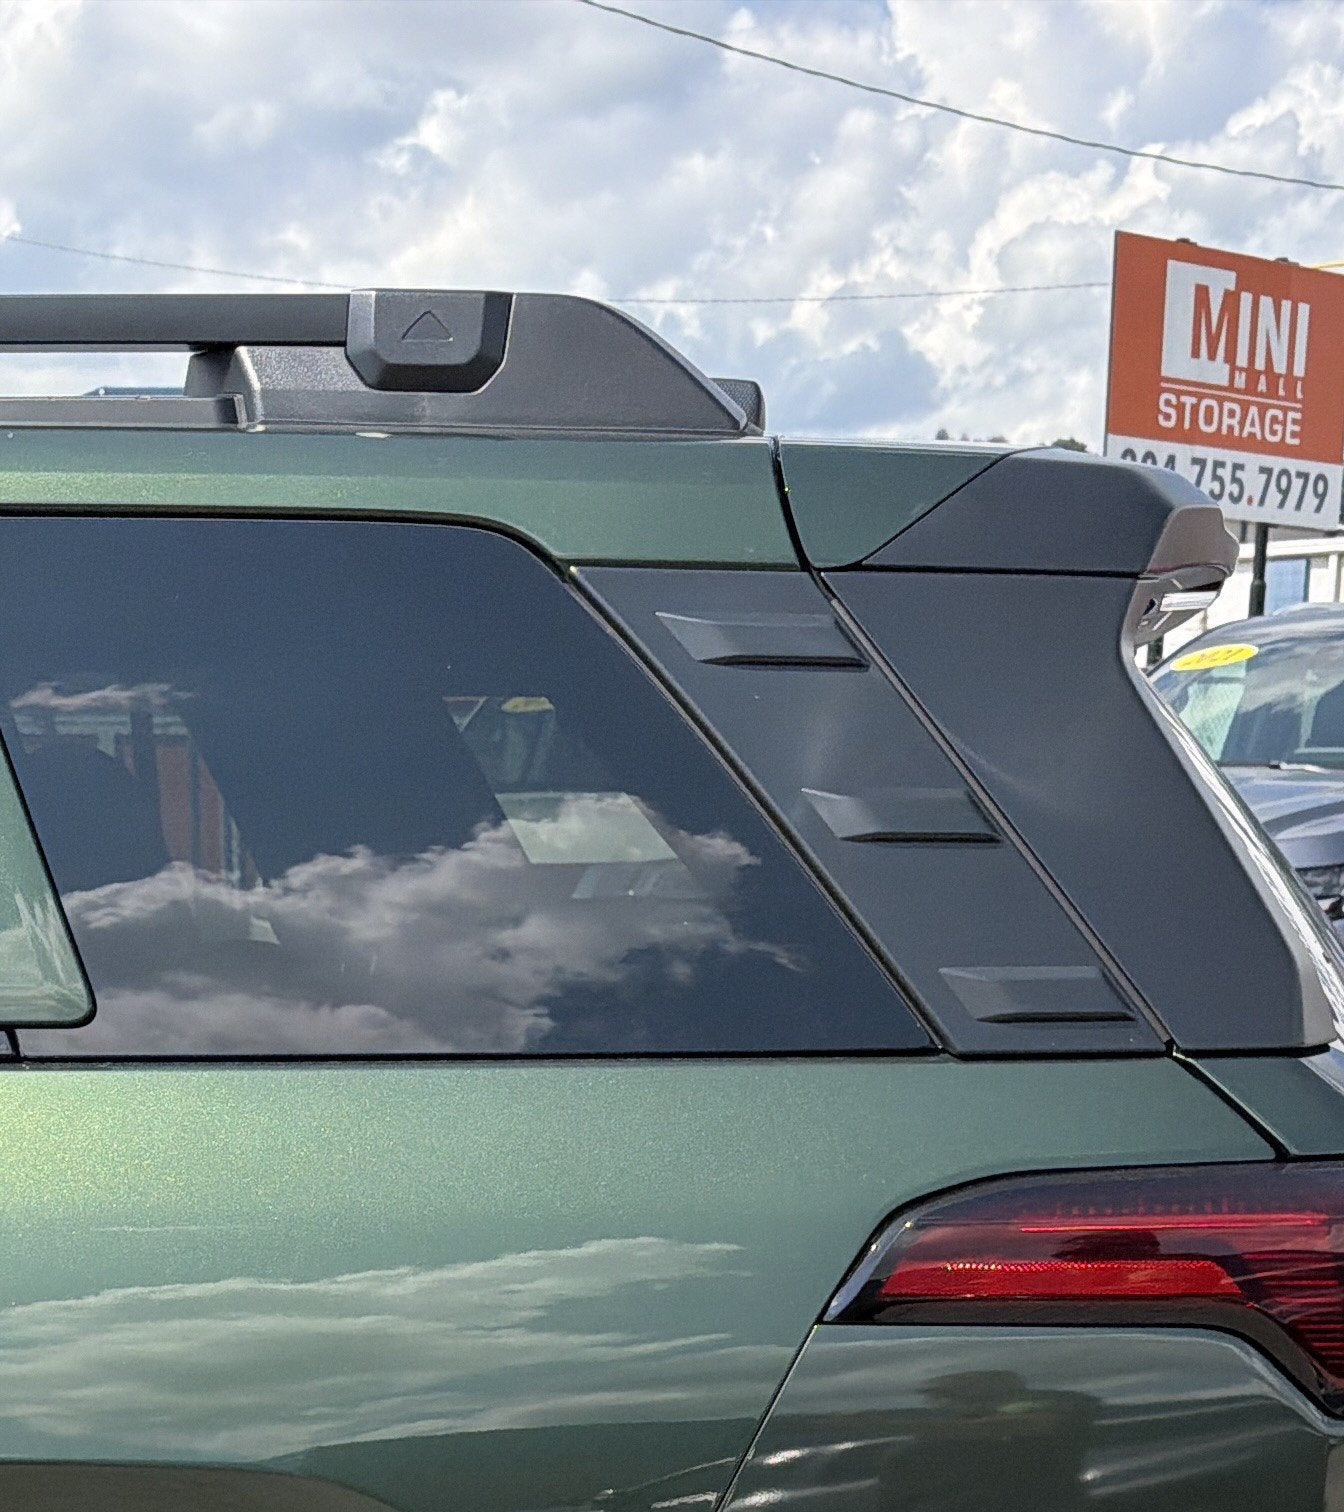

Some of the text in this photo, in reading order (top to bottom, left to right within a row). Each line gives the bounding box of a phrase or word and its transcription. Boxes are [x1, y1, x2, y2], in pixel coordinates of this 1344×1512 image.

[1187, 280, 1311, 378] MINI
[1233, 370, 1304, 400] MALL
[1157, 392, 1303, 446] STORAGE
[1120, 447, 1328, 514] 755.7979
